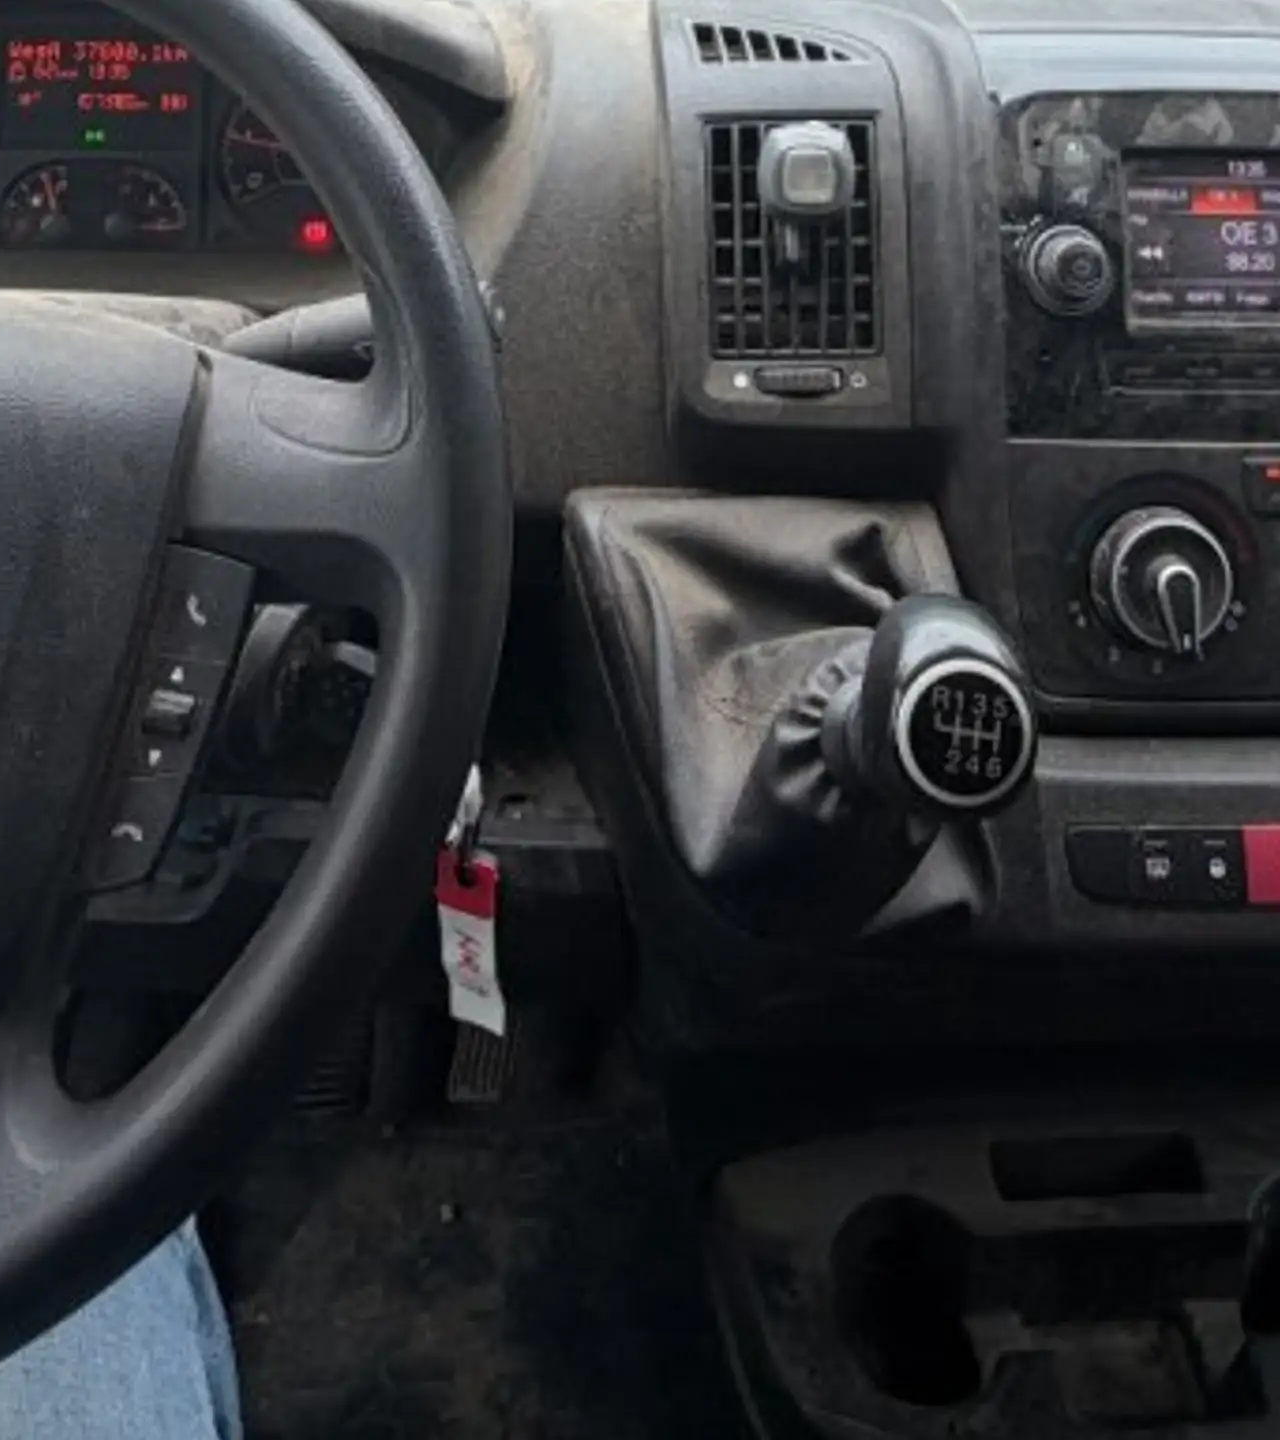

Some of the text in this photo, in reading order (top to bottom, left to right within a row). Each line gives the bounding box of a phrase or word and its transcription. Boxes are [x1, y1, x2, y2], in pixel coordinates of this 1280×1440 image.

[932, 686, 1009, 718] R 1 3 5
[944, 750, 1002, 778] 2 4 6
